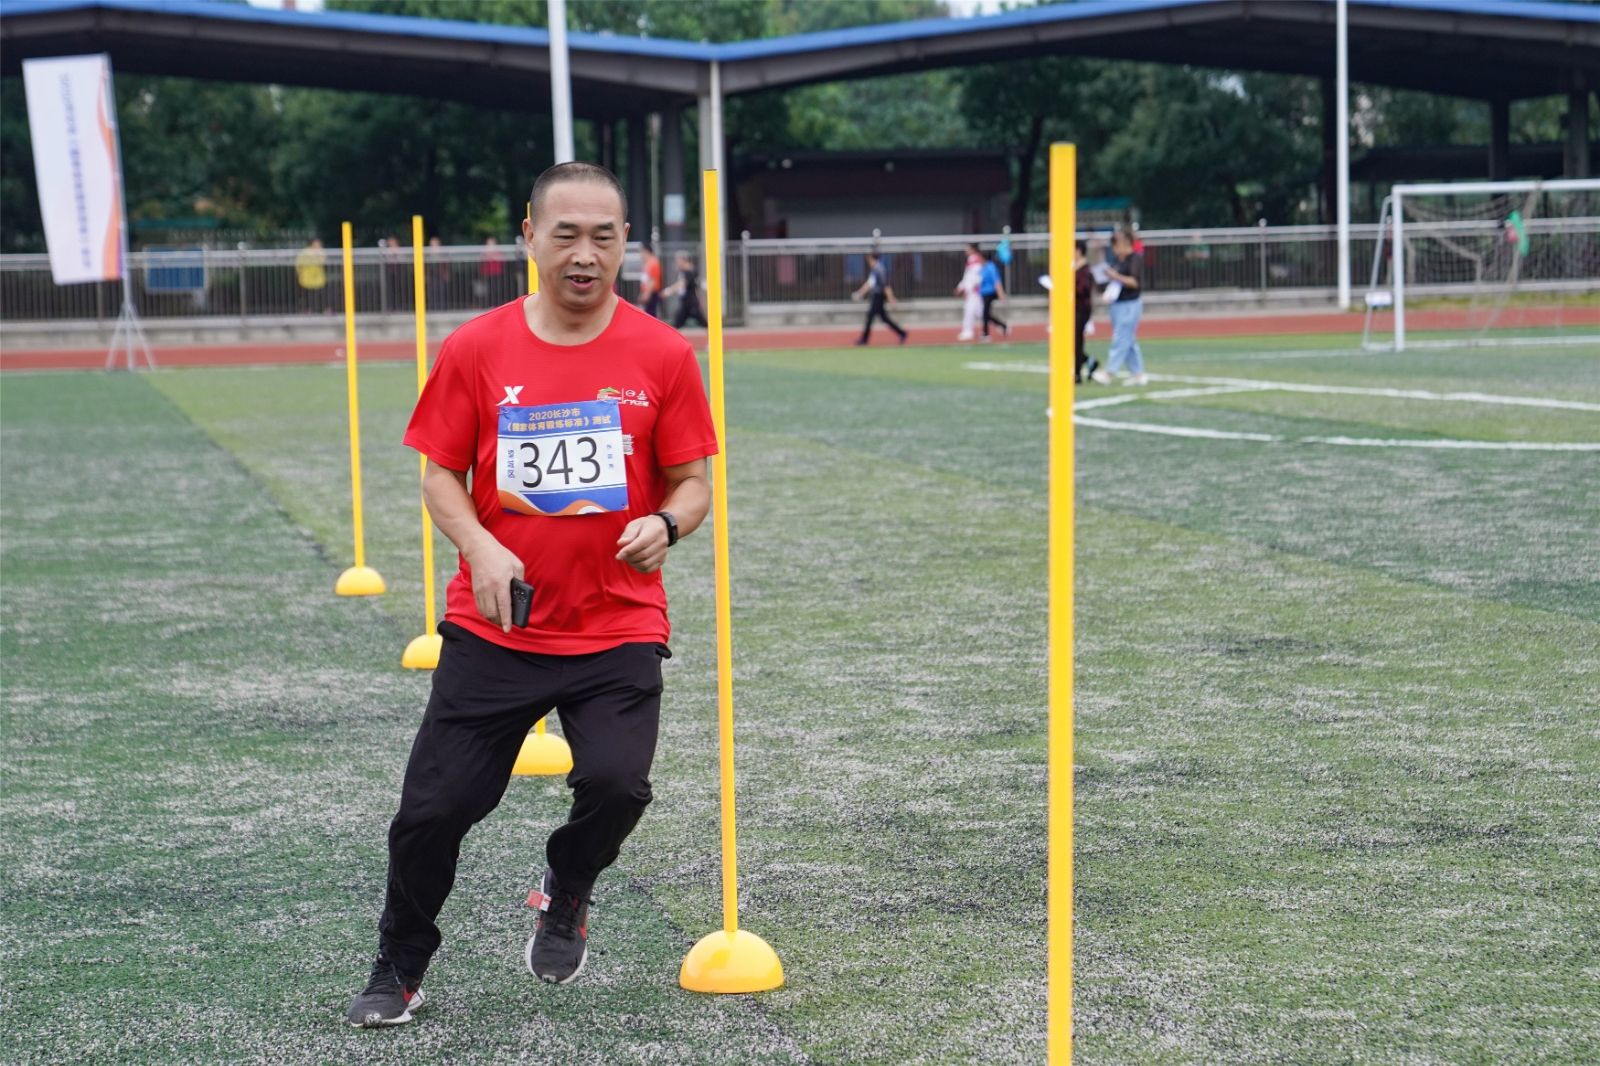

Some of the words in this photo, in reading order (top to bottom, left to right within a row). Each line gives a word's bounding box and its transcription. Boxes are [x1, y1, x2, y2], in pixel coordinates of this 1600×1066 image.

[529, 407, 581, 422] 2020长沙市
[520, 436, 601, 489] 343
